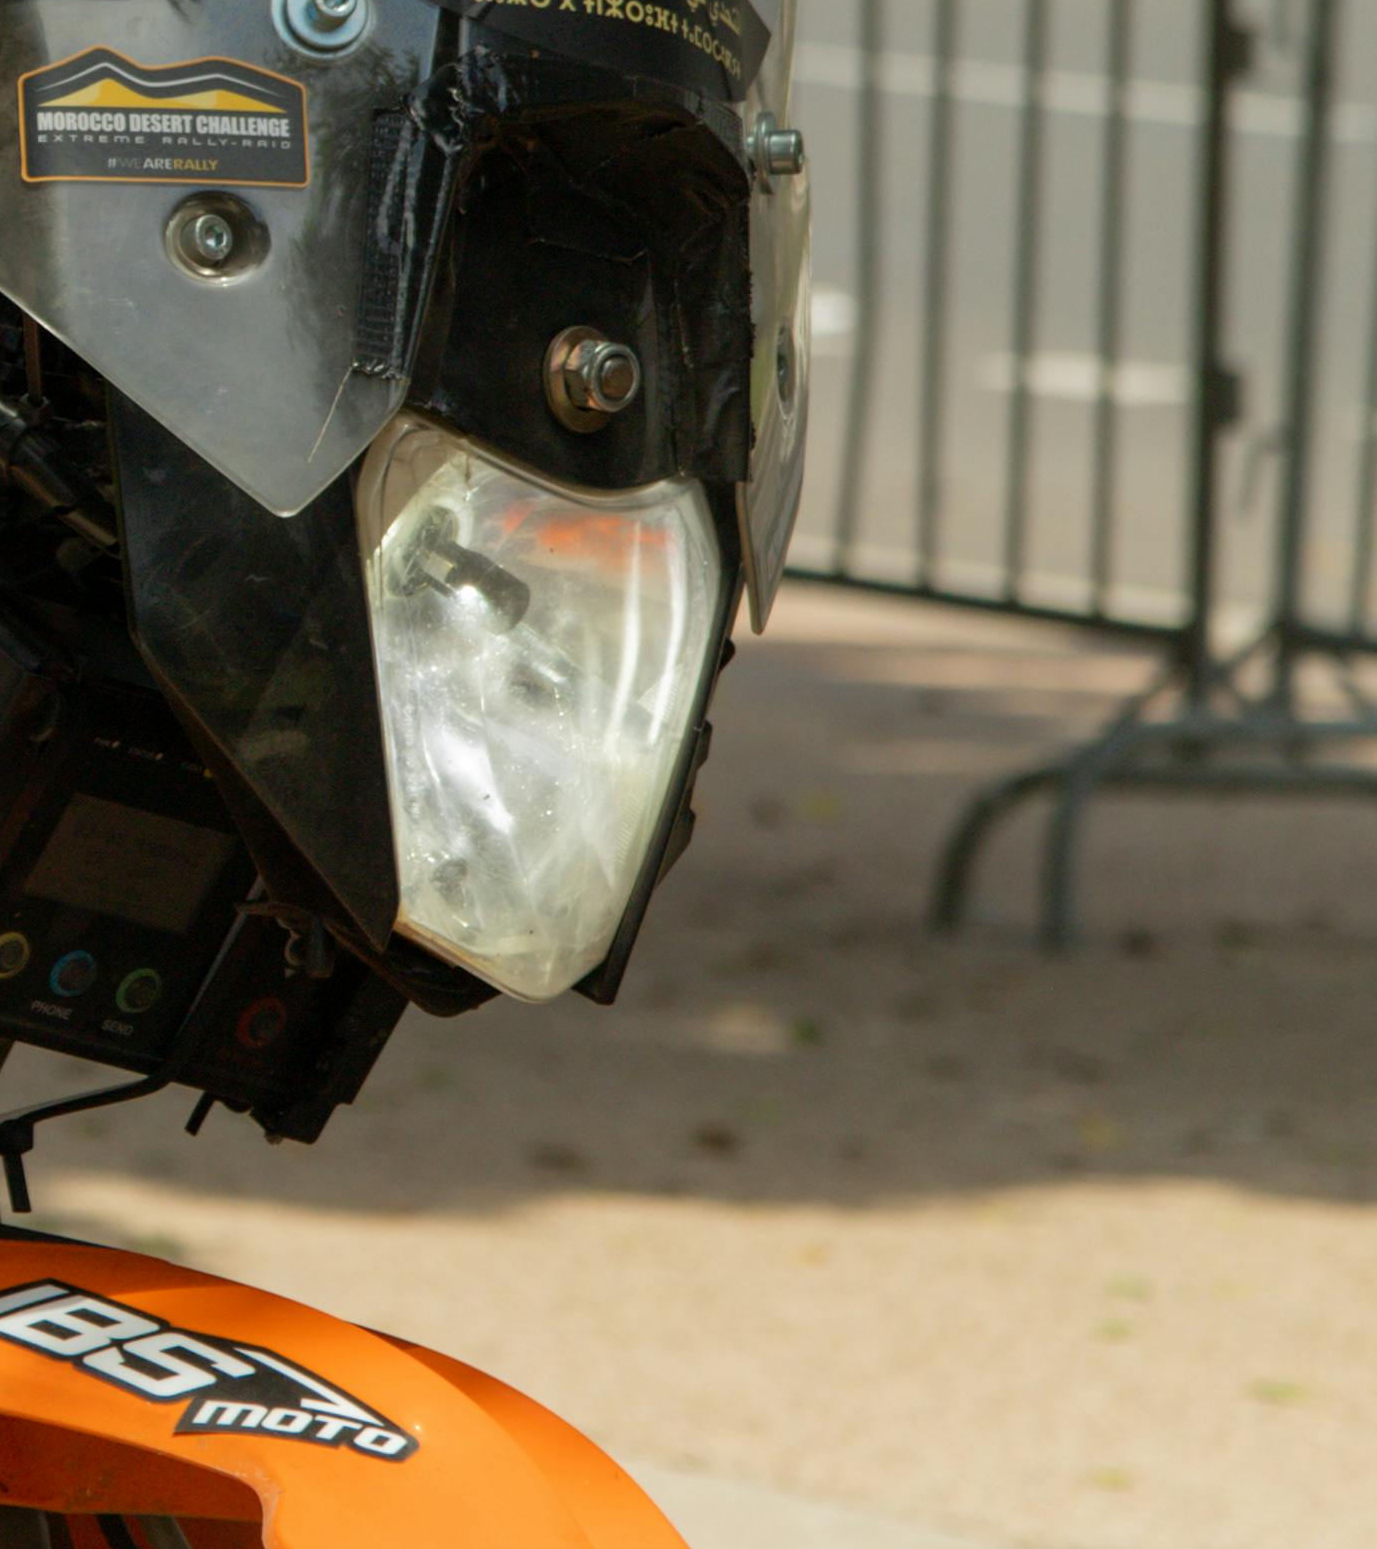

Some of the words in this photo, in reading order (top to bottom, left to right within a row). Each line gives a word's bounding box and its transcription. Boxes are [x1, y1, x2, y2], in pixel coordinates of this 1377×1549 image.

[37, 112, 126, 132] MOROCCO
[129, 114, 192, 134] DESERT
[196, 115, 290, 137] CHALLENGE
[38, 135, 145, 144] EXTREME
[162, 137, 291, 149] RALLY-RAID
